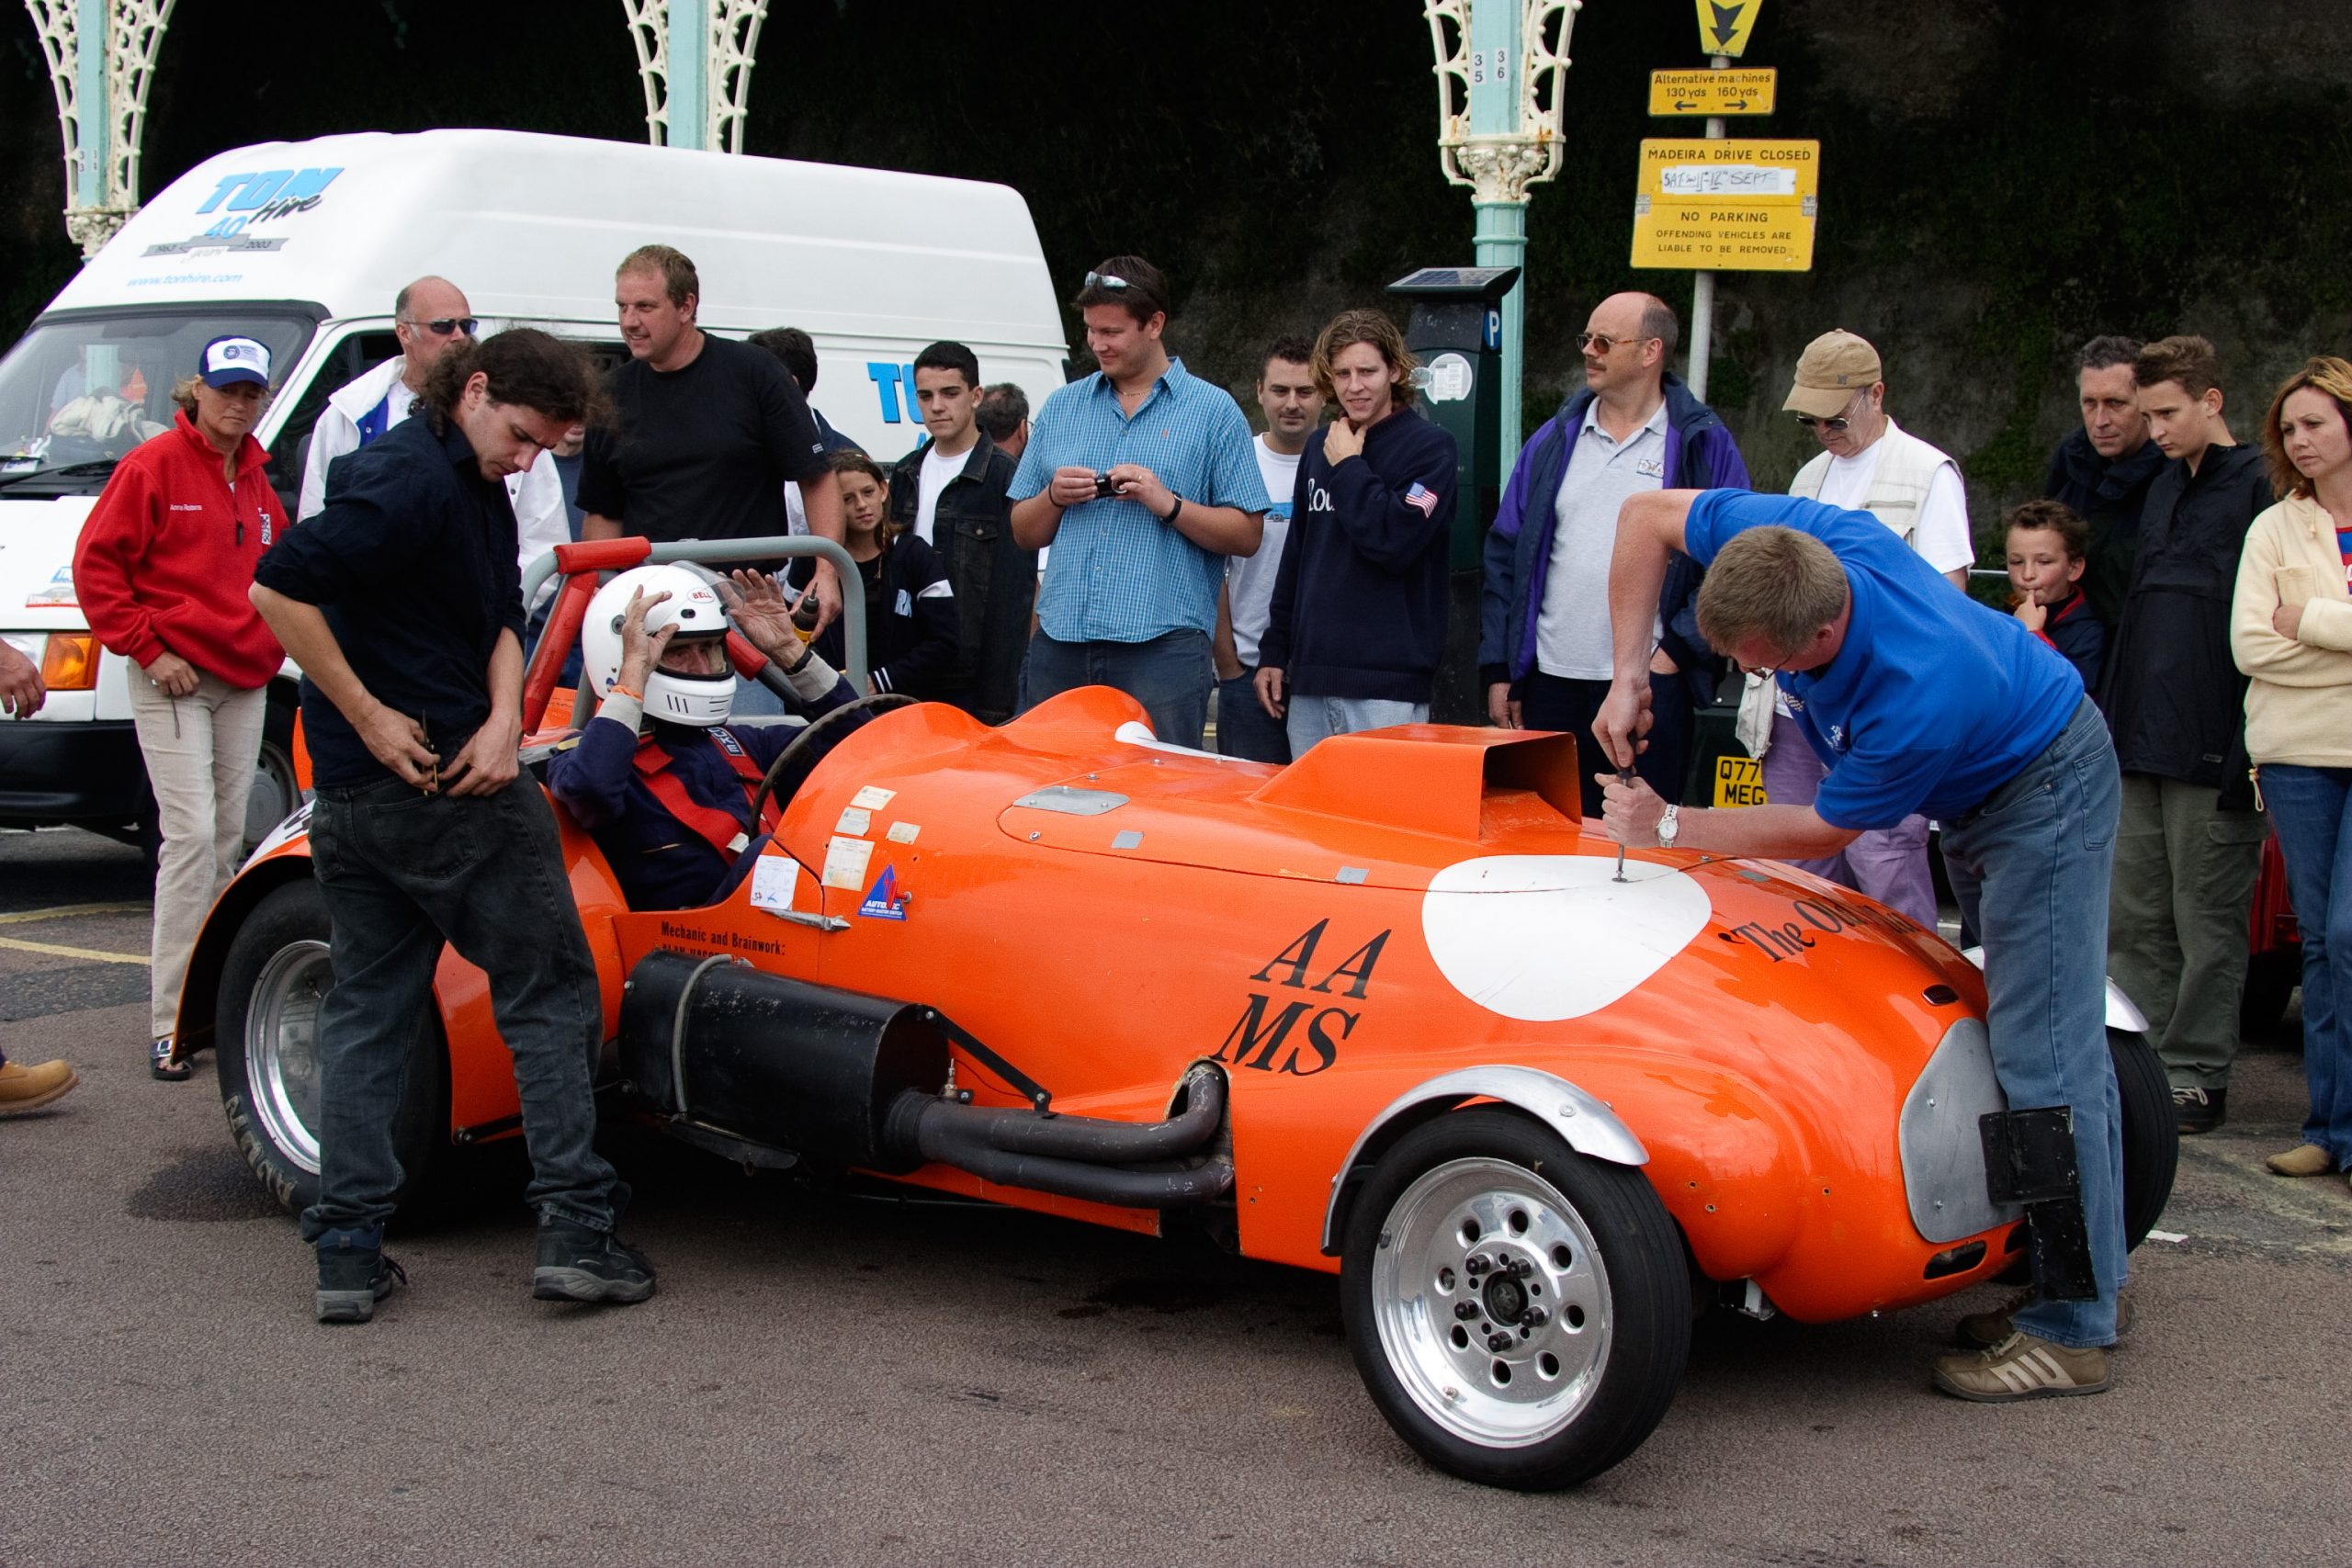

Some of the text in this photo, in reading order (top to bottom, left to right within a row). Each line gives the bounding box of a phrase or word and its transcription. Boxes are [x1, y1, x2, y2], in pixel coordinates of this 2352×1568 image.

[1654, 72, 1771, 85] Alternative machines
[1666, 85, 1758, 98] 130 yds 160 yds
[1647, 149, 1812, 161] MADEIRA DRIVE CLOSED
[195, 166, 345, 215] TON
[247, 194, 323, 224] Hire
[1679, 211, 1769, 222] NO PARKING
[203, 215, 248, 240] 40
[1656, 230, 1792, 240] OFFENDING VEHICLES ARE
[1657, 244, 1787, 254] LIABLE TO BE REMOVED
[1488, 310, 1500, 347] P
[692, 591, 713, 600] BELL
[1724, 783, 1765, 806] MEG
[661, 920, 707, 942] Mechanic
[710, 931, 729, 946] and
[731, 932, 786, 956] Brainwork:
[1208, 992, 1362, 1077] MS
